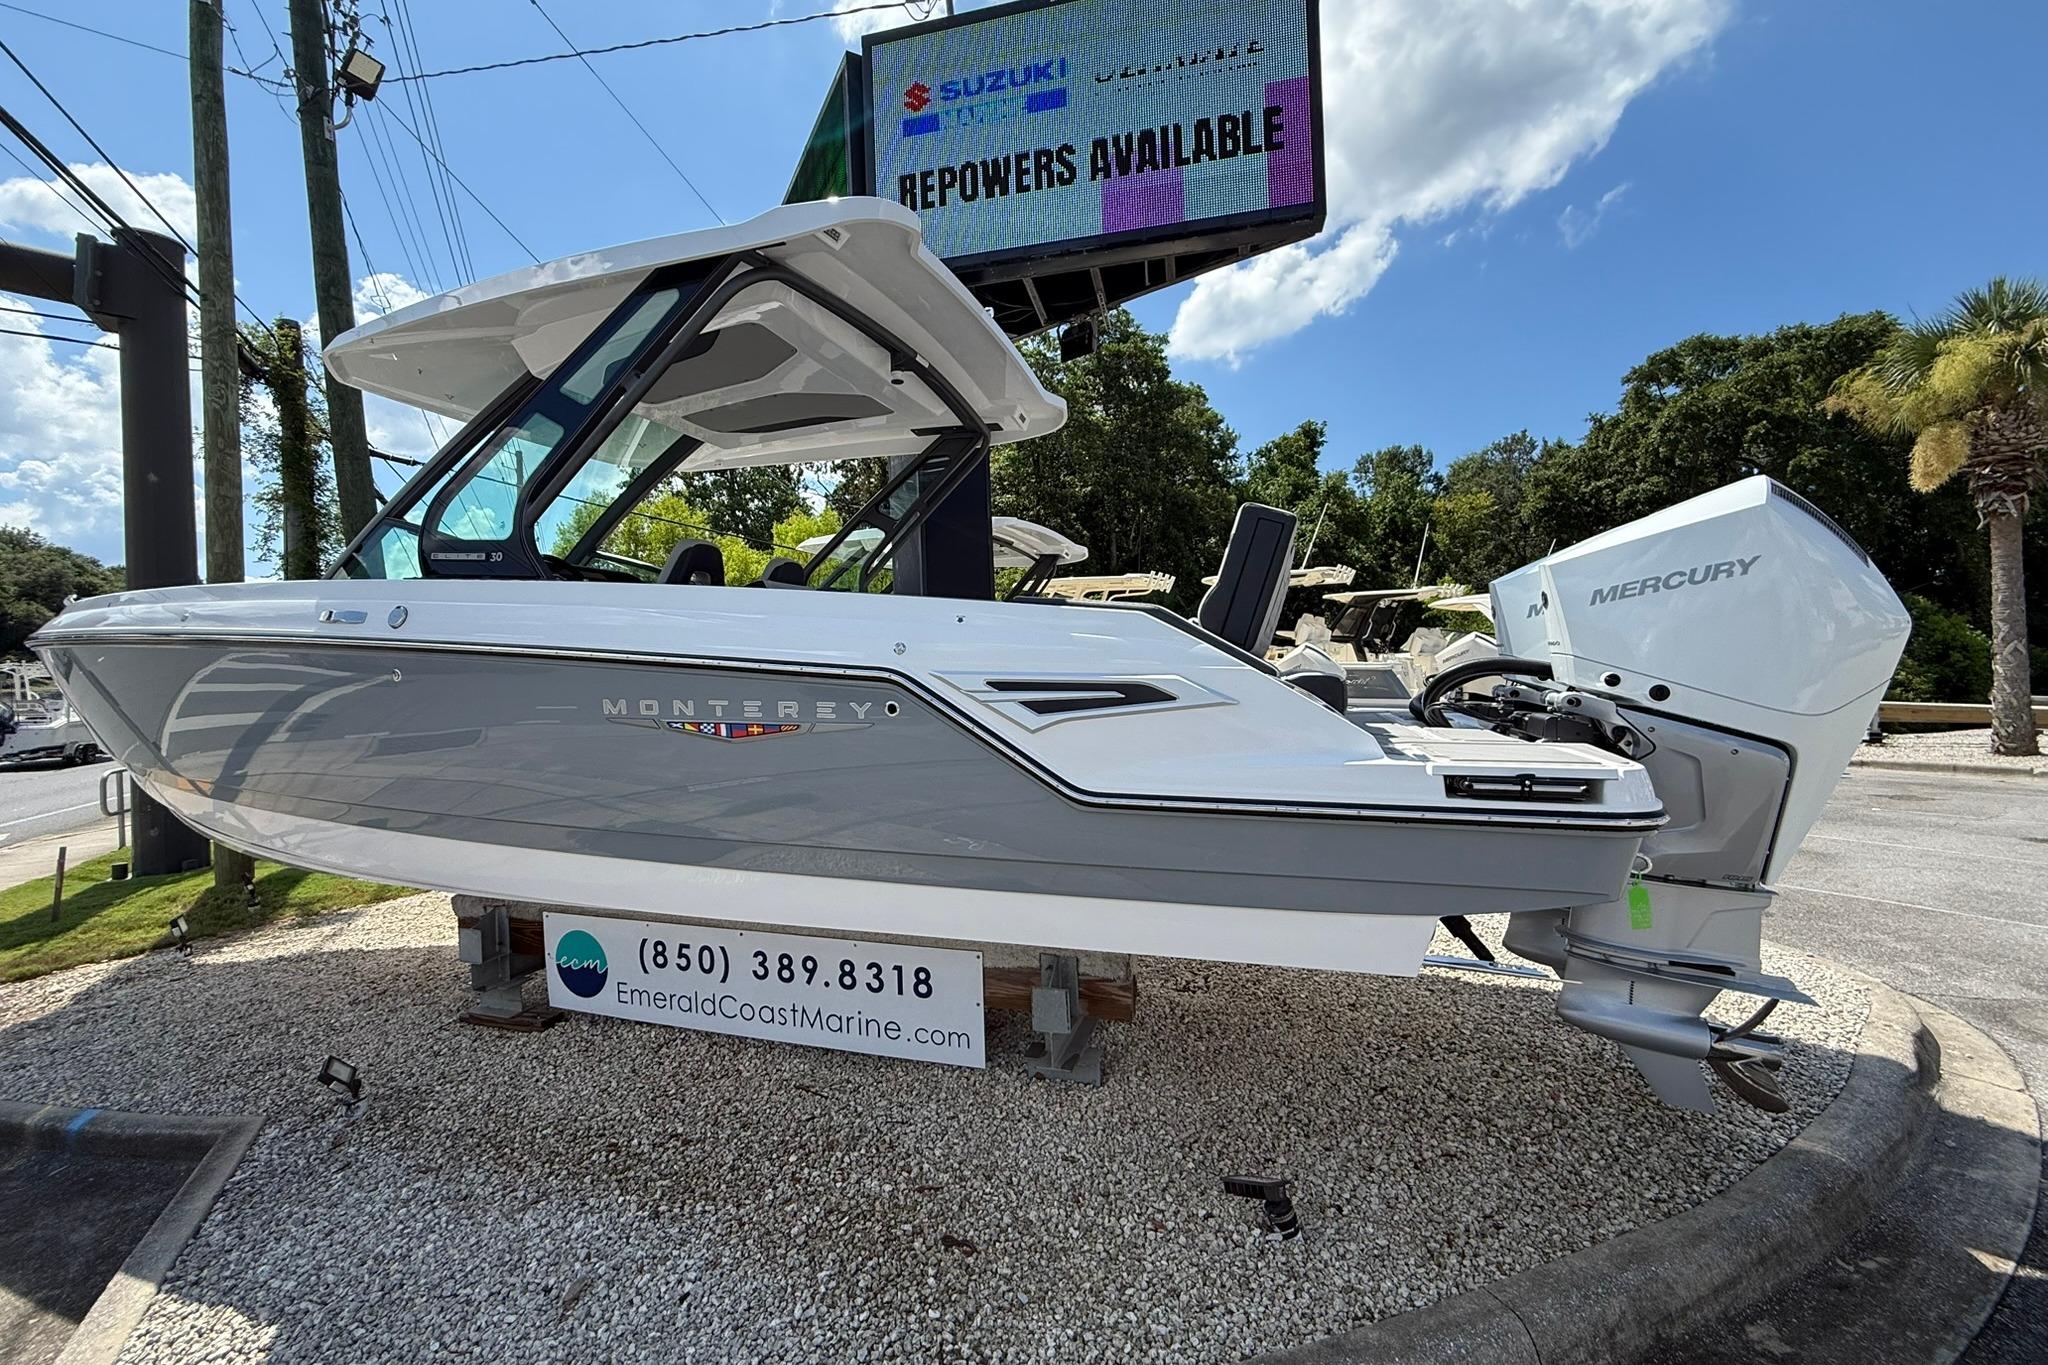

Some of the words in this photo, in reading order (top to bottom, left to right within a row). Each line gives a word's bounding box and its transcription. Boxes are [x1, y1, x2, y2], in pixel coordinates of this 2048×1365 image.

[939, 57, 1067, 101] SUZUKI
[899, 142, 1077, 213] REPOWERS
[1090, 104, 1285, 181] AVAILABLE
[490, 552, 503, 561] 30
[1589, 554, 1762, 606] MERCURY
[603, 699, 872, 719] MONTEREY
[639, 937, 730, 983] (850)
[752, 950, 934, 999] 389.8318
[616, 982, 970, 1049] EmeraldCoastMarine.com
